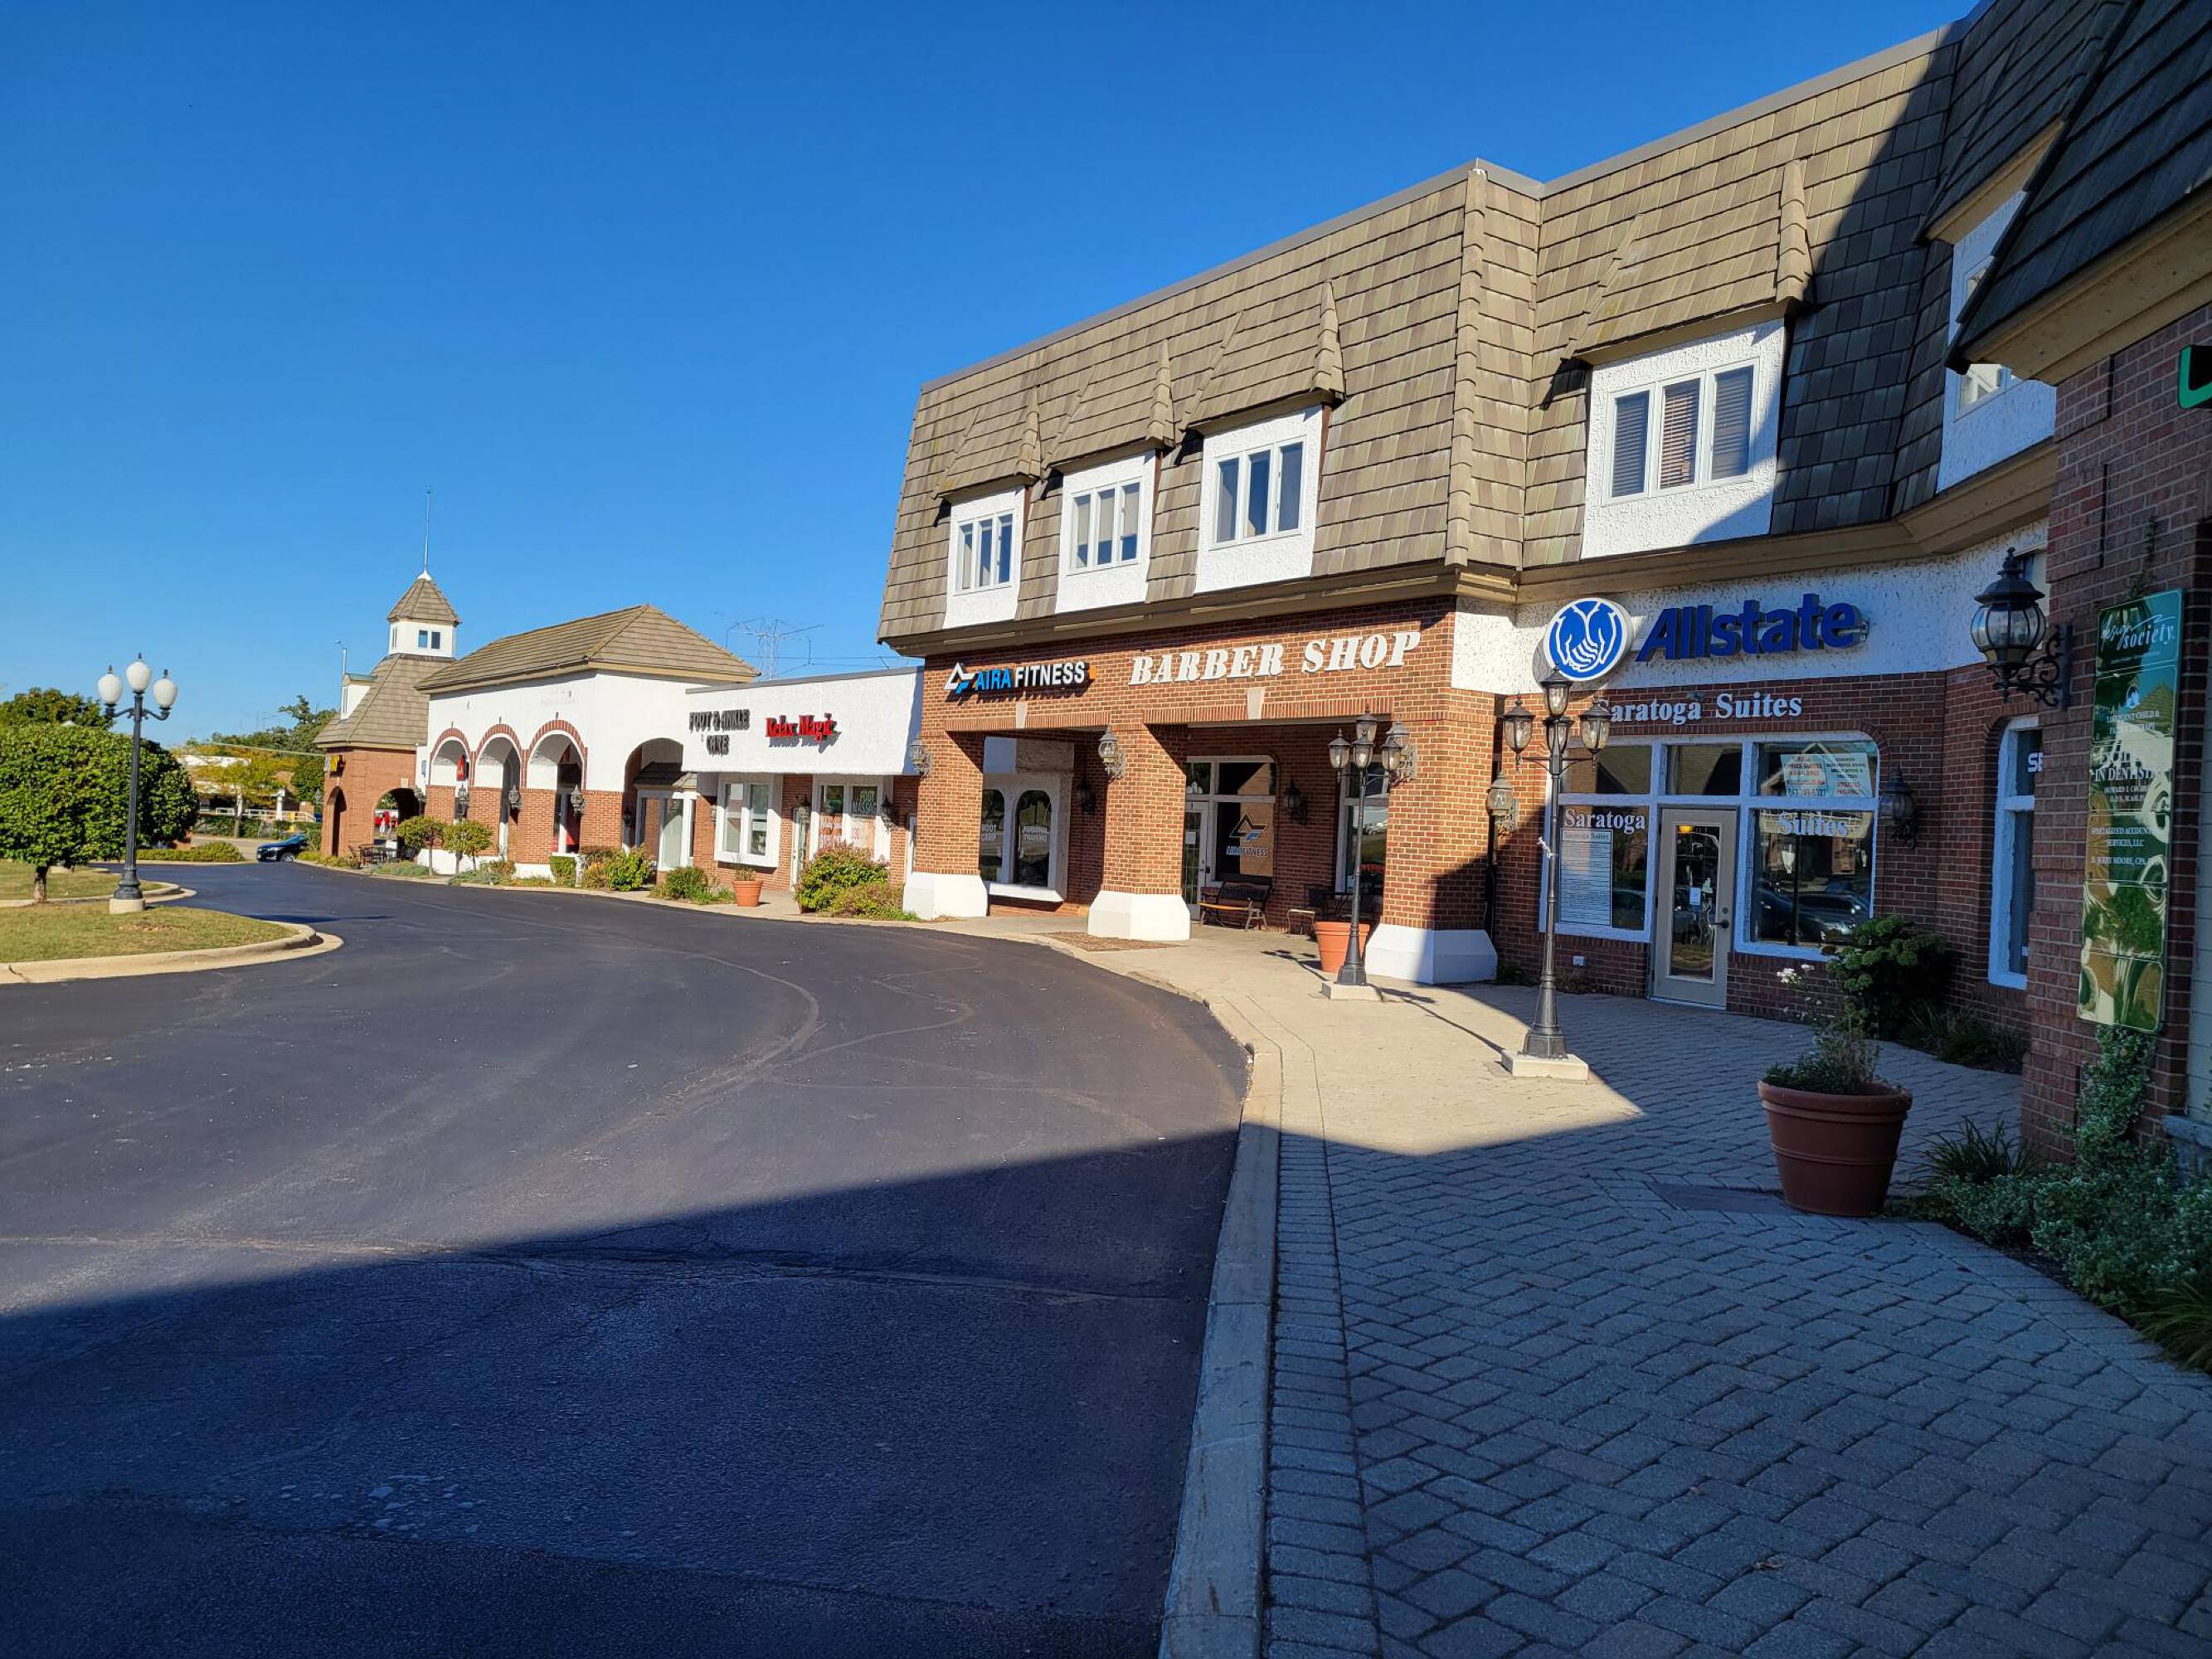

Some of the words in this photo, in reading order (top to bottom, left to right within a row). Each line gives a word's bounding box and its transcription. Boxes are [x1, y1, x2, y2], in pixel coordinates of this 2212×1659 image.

[1635, 593, 1861, 662] Allstate
[2121, 622, 2175, 649] society
[1128, 643, 1285, 685] BARBER
[1301, 631, 1421, 674] SHOP
[974, 668, 1011, 690] AIRA
[1014, 661, 1086, 688] FITNESS
[1715, 691, 1803, 718] Suites
[689, 711, 712, 732] FOOT
[721, 709, 750, 730] ANKLE
[765, 716, 798, 737] Relax
[799, 713, 837, 742] Magic
[707, 734, 729, 755] CARE
[1564, 808, 1646, 834] Saratoga
[1778, 811, 1849, 837] Suites
[1242, 847, 1268, 858] FITNESS
